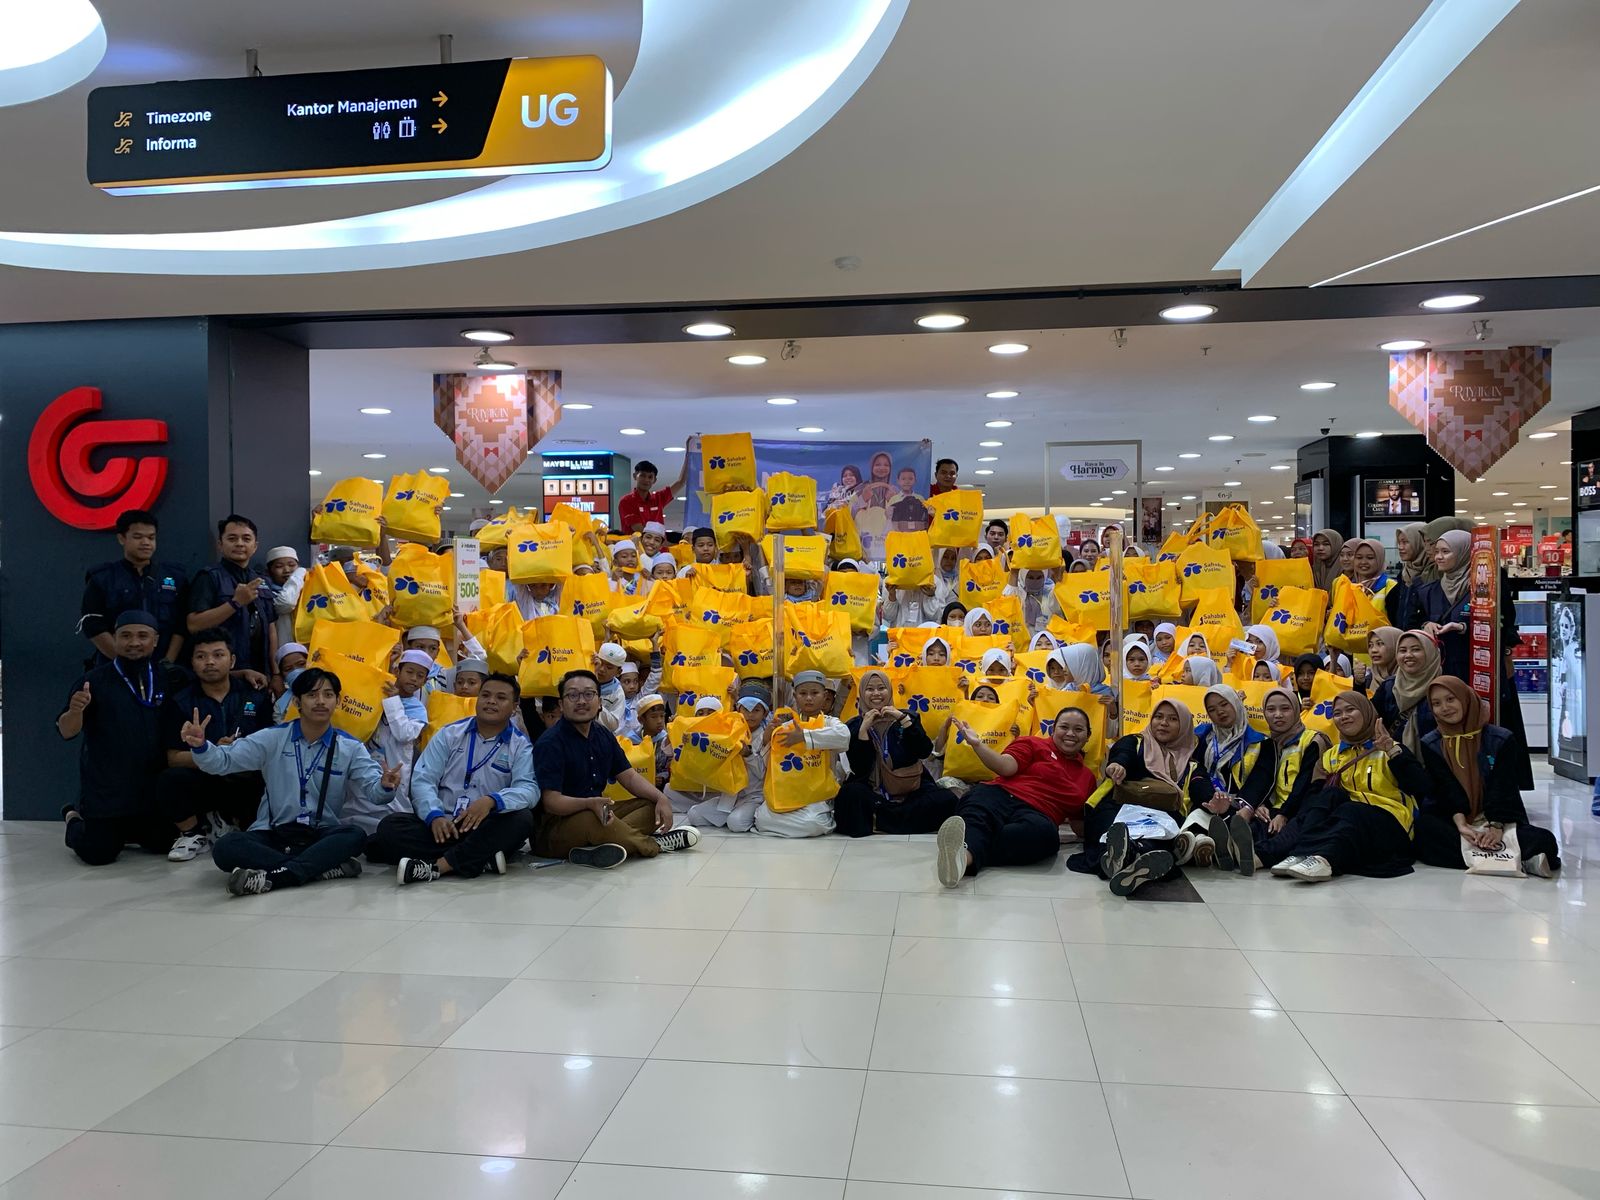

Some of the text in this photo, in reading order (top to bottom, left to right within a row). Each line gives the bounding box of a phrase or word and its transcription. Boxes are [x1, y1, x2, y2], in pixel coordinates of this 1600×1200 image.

[286, 96, 418, 117] Kantor Manajemen
[520, 92, 579, 128] UG
[146, 108, 212, 125] Timezone
[146, 136, 197, 152] Informa
[1070, 465, 1117, 478] Harmony
[1580, 486, 1596, 496] BOSS
[350, 500, 374, 510] Sahabat
[421, 587, 441, 595] Yatim
[341, 704, 362, 717] Yatim
[343, 695, 373, 713] Sahabat
